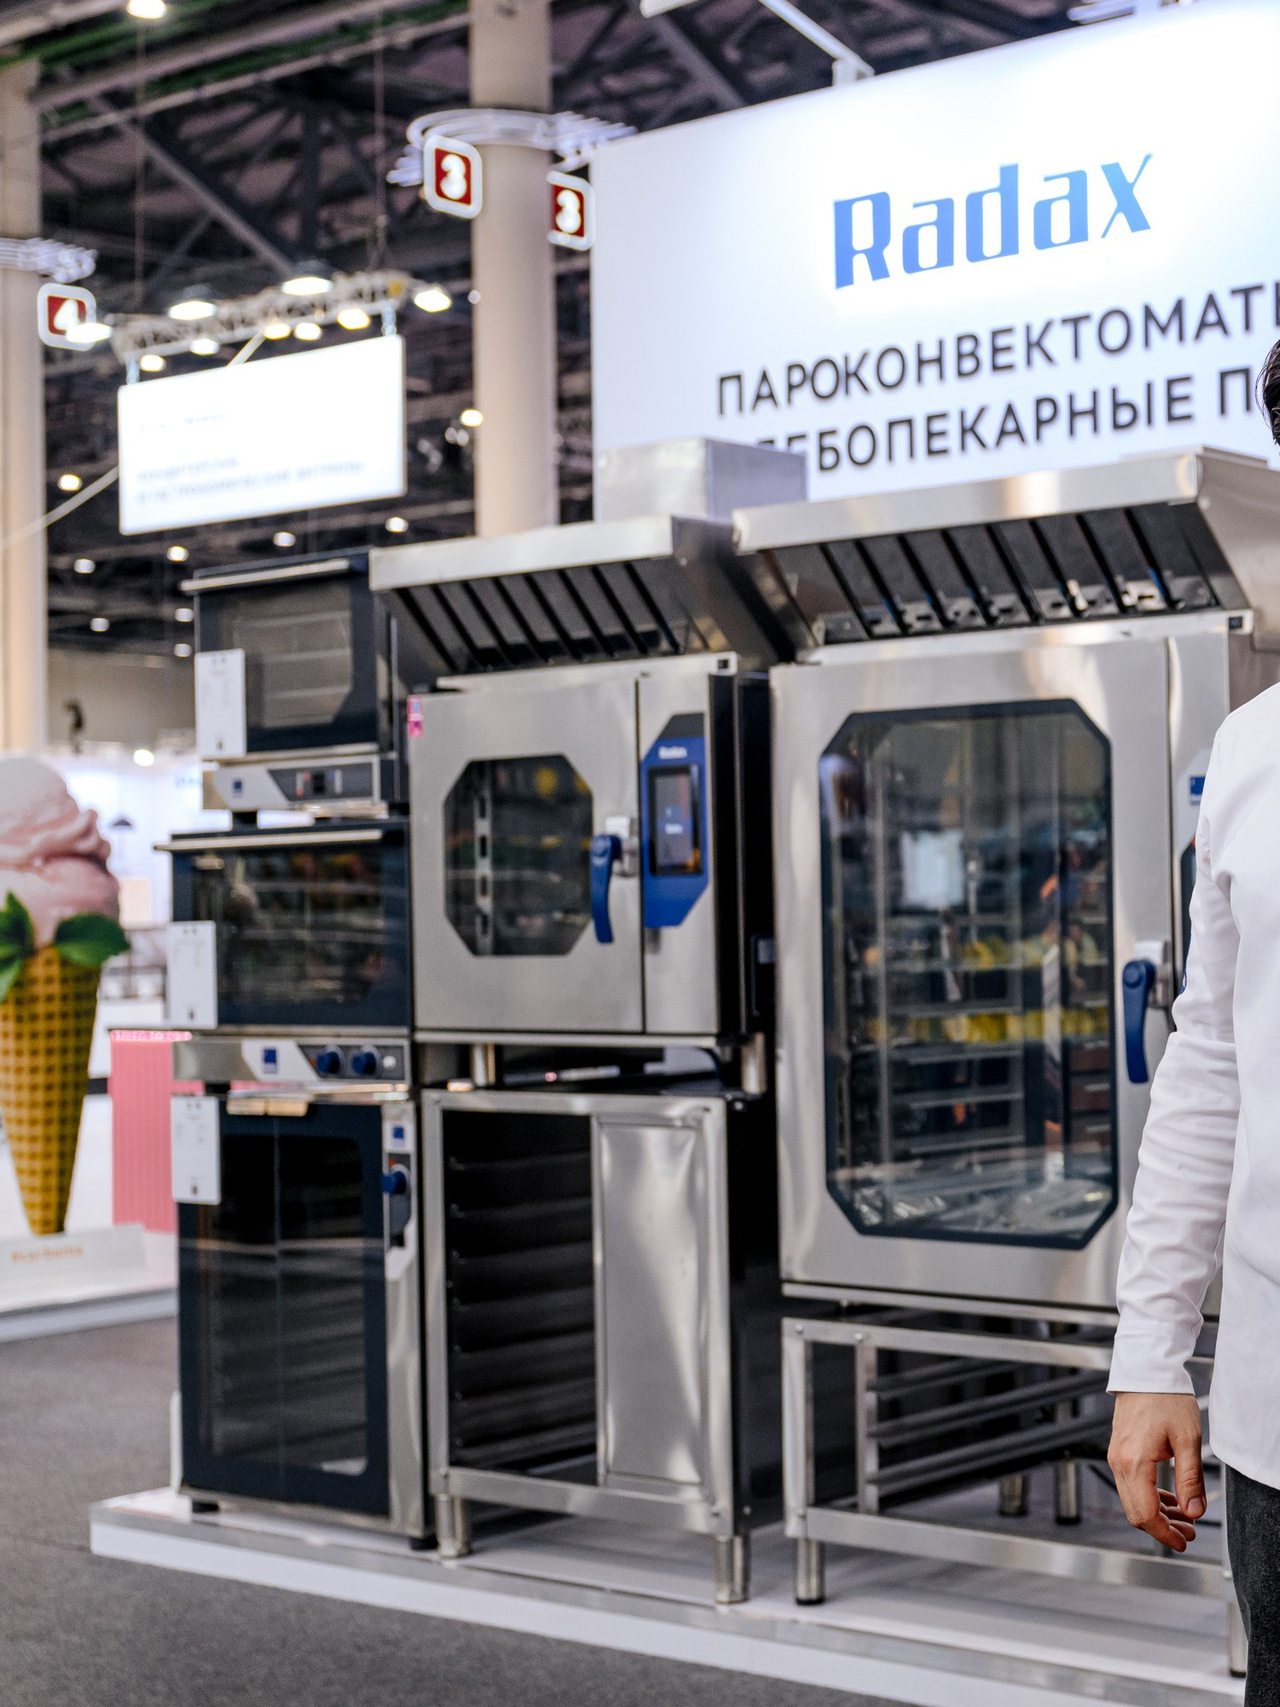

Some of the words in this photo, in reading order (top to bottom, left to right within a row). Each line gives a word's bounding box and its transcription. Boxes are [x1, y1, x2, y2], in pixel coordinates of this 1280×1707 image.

[440, 153, 467, 200] 3
[555, 189, 582, 234] 3
[834, 153, 1152, 290] Radax
[757, 374, 1193, 472] БОПЕКАРНЫЕ
[1219, 367, 1253, 415] П
